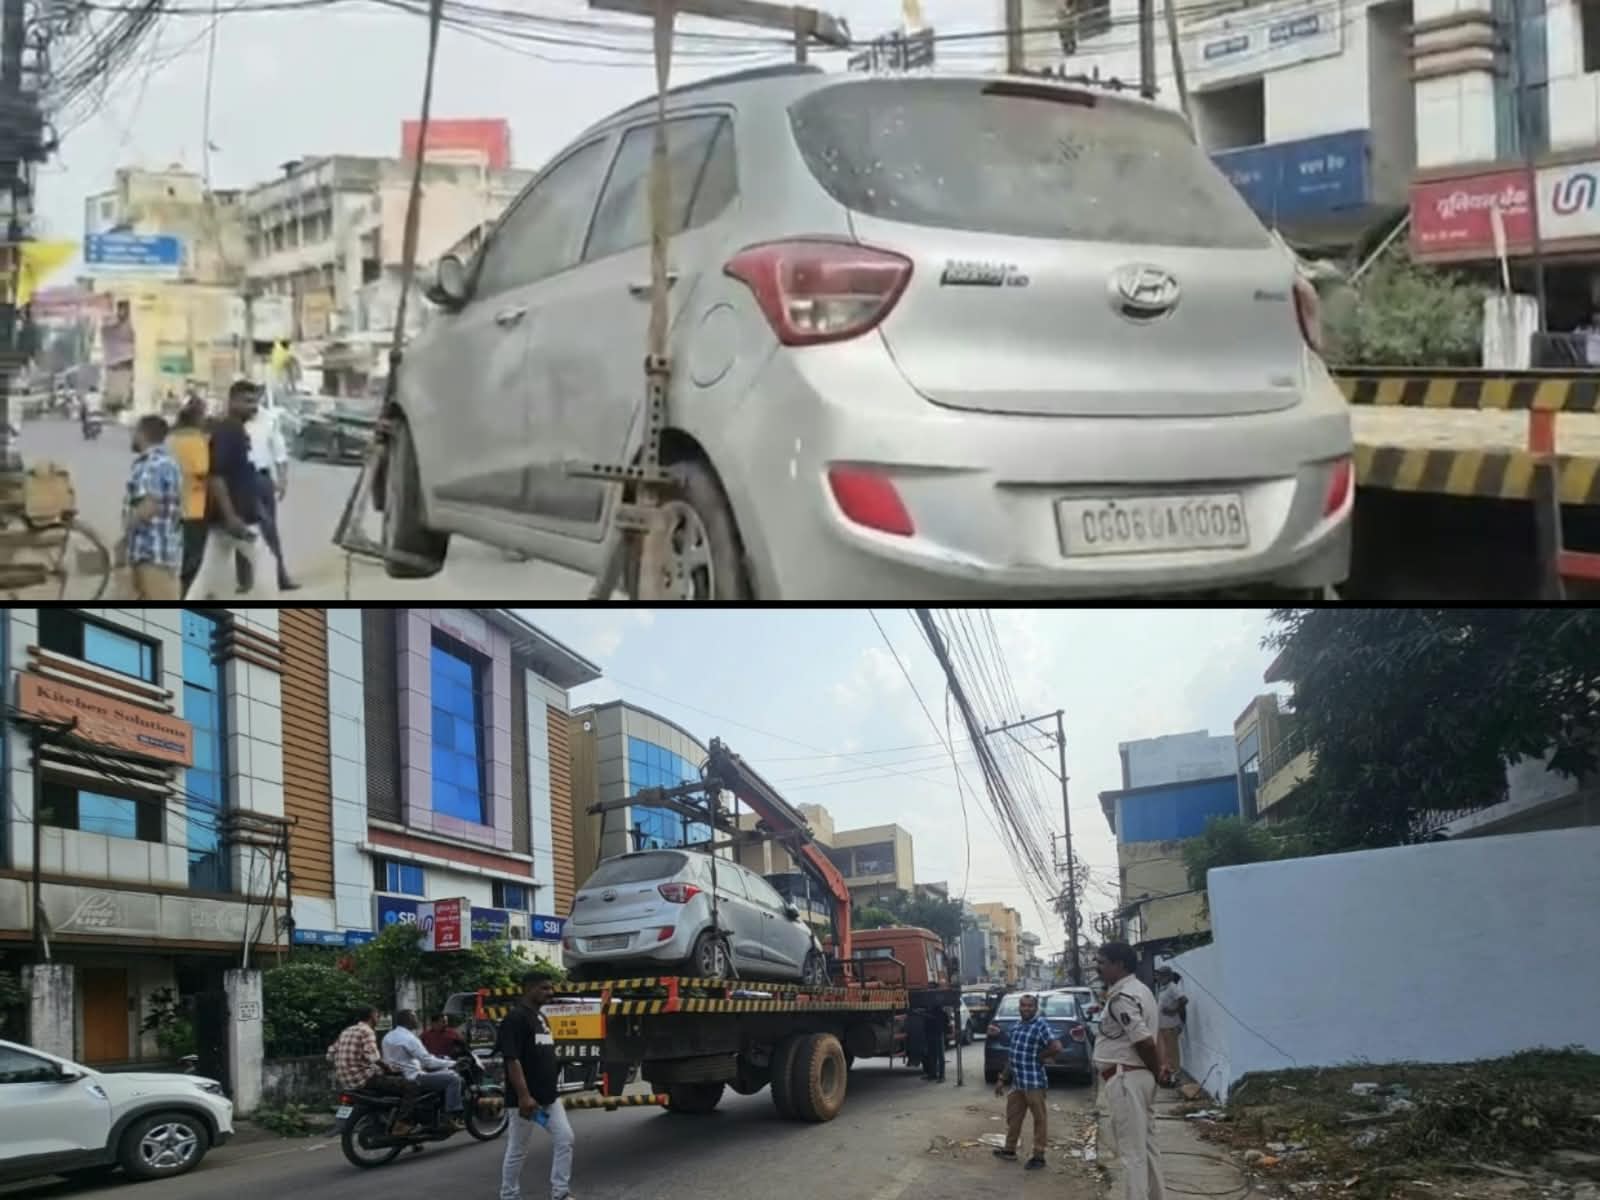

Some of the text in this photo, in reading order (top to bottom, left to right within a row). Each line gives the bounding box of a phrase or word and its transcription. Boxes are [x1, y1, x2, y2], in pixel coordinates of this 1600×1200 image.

[37, 685, 186, 738] Kitchen Solutions
[398, 911, 418, 926] SB
[543, 919, 561, 935] SBI
